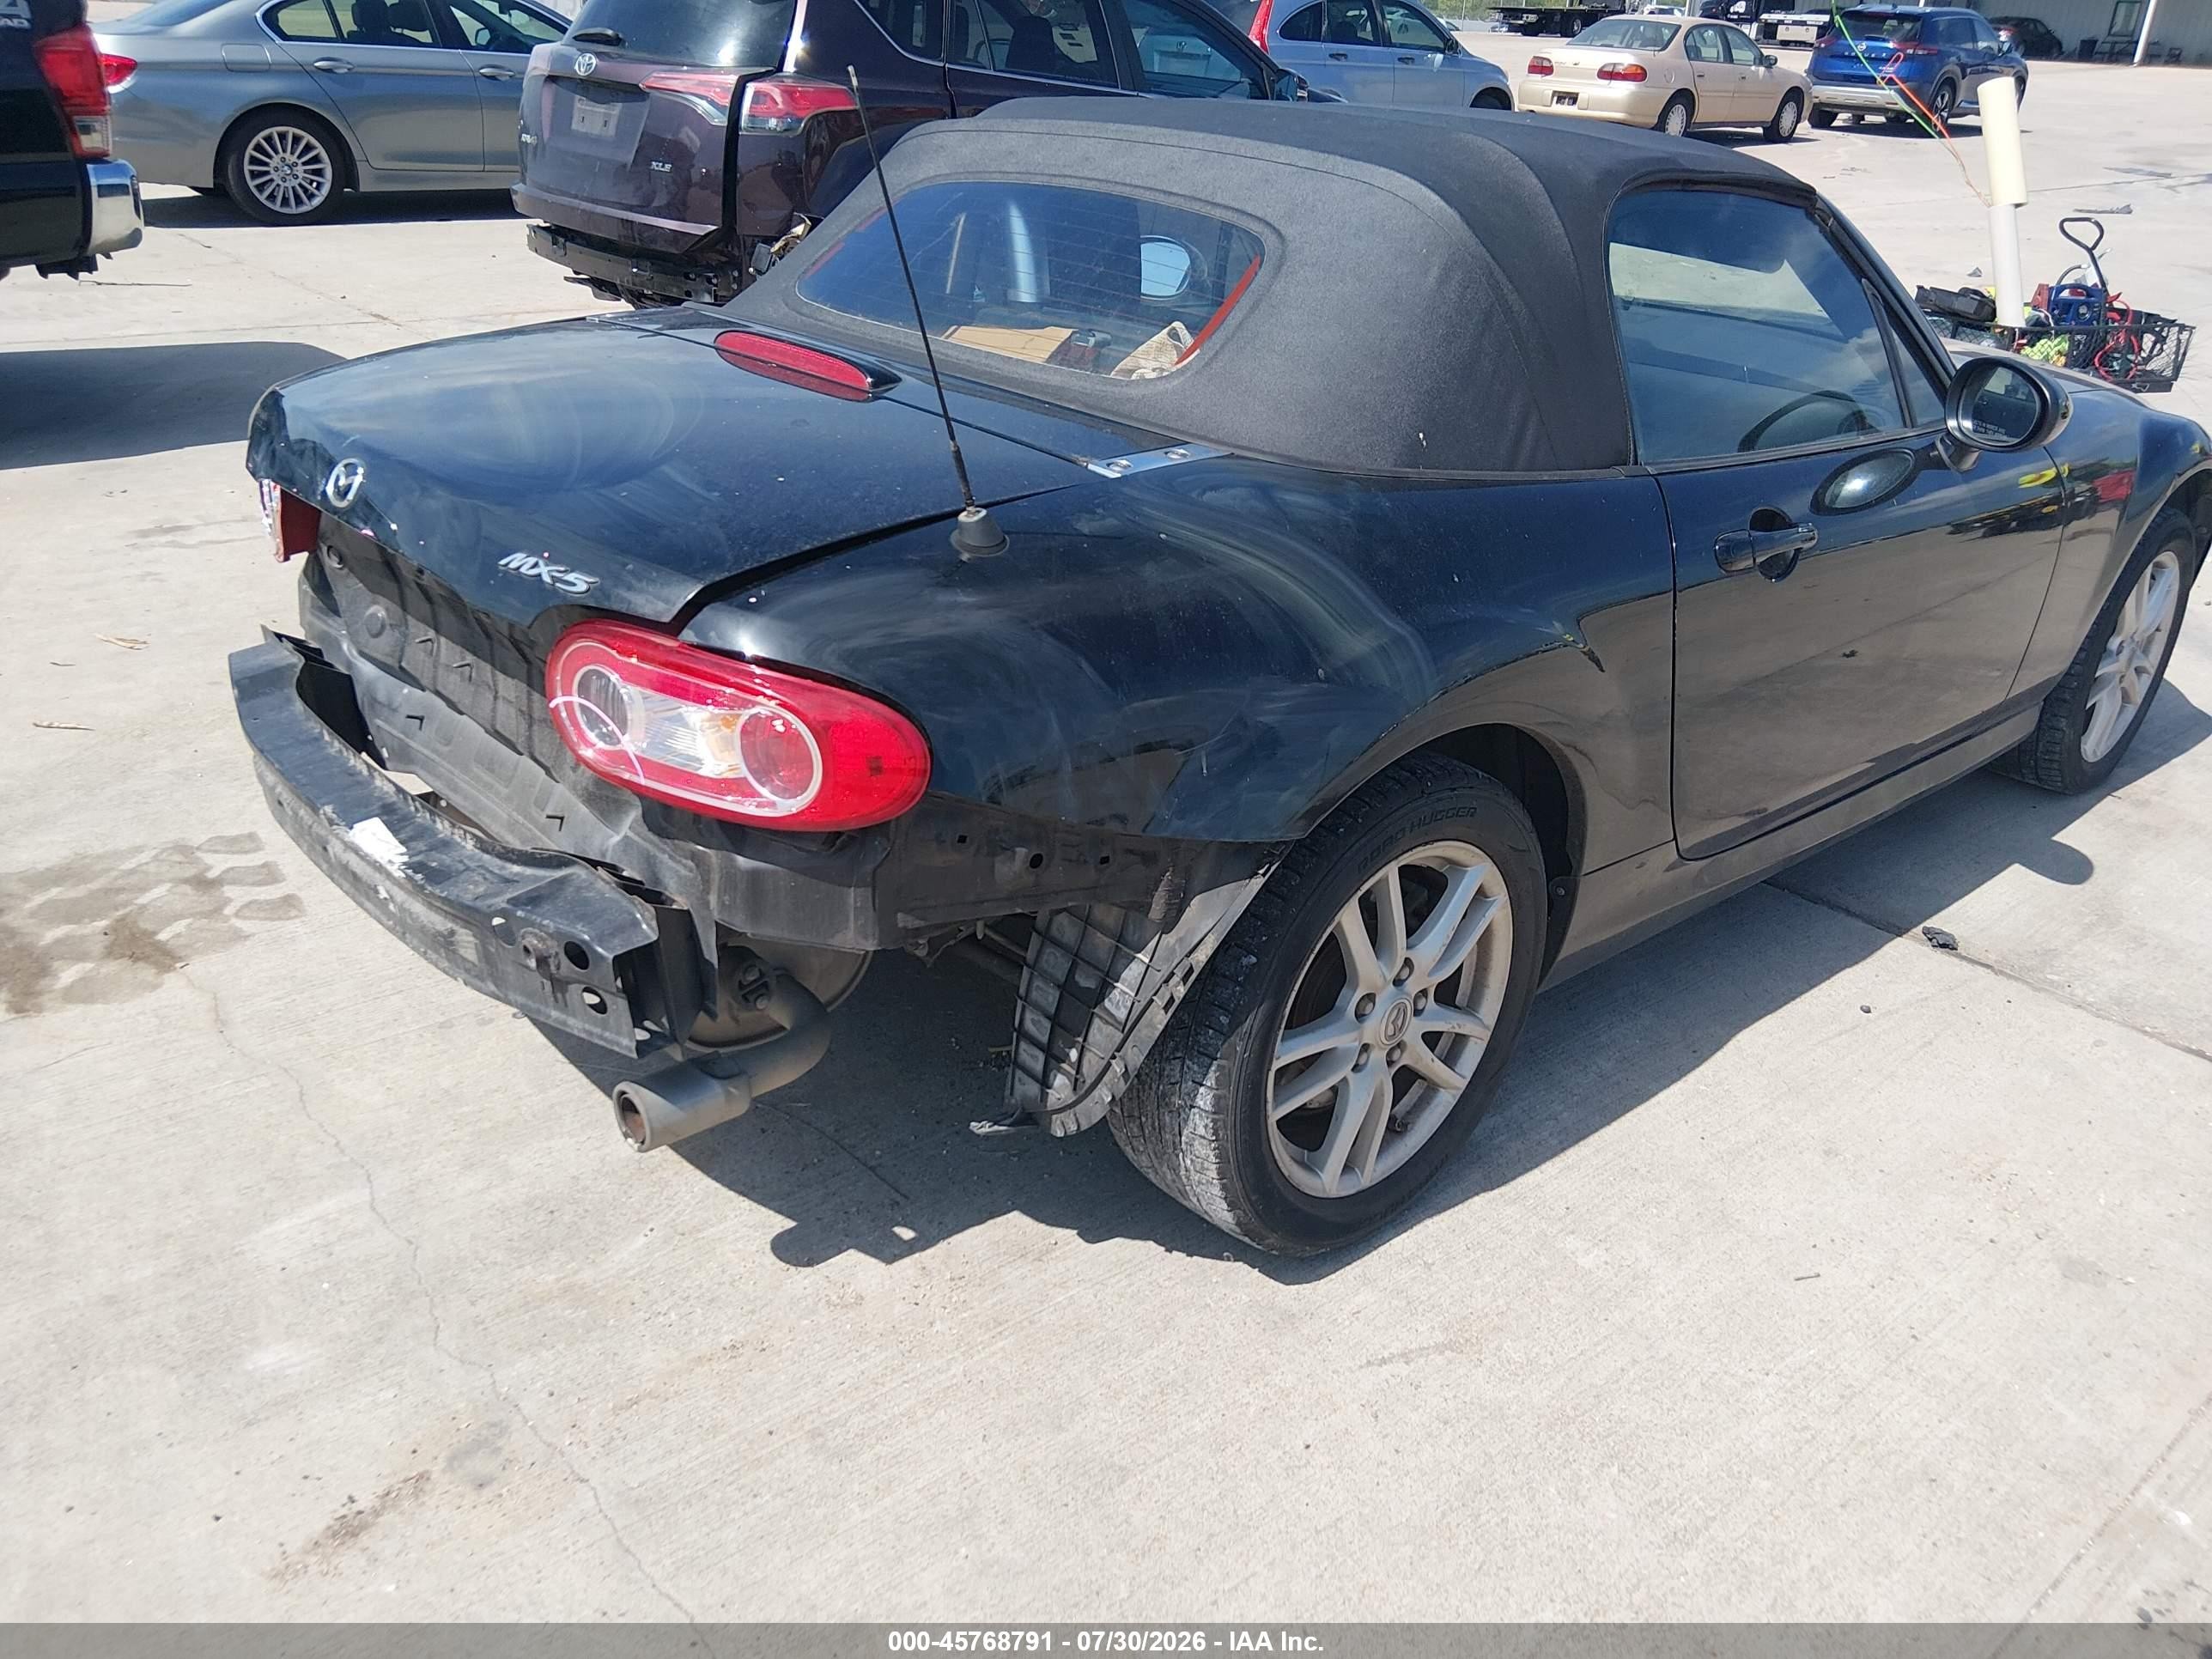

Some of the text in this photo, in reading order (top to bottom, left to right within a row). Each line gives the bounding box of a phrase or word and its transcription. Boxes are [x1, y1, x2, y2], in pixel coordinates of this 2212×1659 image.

[651, 161, 672, 173] XLE
[497, 551, 601, 595] MX-5
[1408, 805, 1478, 833] HUGGER
